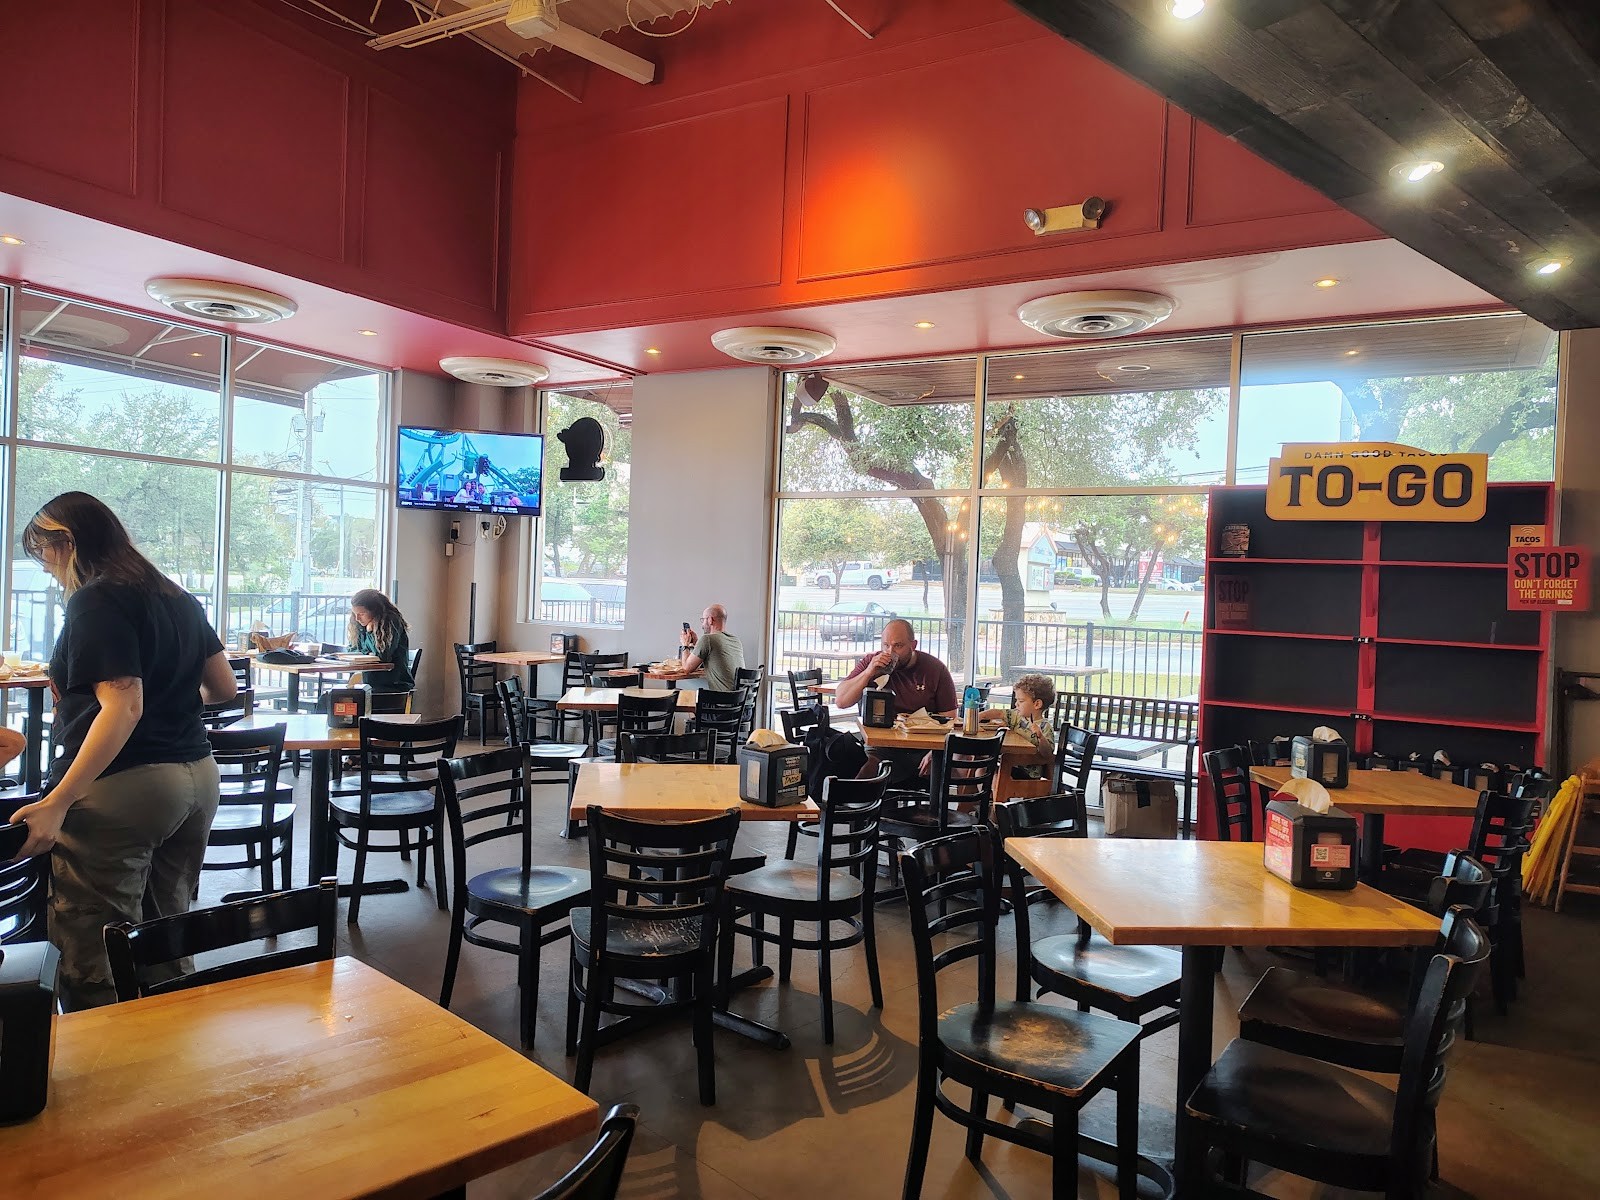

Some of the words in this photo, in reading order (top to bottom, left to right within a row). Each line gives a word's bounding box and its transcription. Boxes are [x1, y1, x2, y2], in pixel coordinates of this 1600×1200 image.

[1279, 463, 1473, 508] TO-GO
[1514, 552, 1580, 578] STOP
[1218, 580, 1249, 603] STOP
[1514, 579, 1542, 589] DON'T
[1543, 579, 1578, 589] FORGET
[1519, 589, 1537, 599] THE
[1539, 589, 1573, 600] DRINKS
